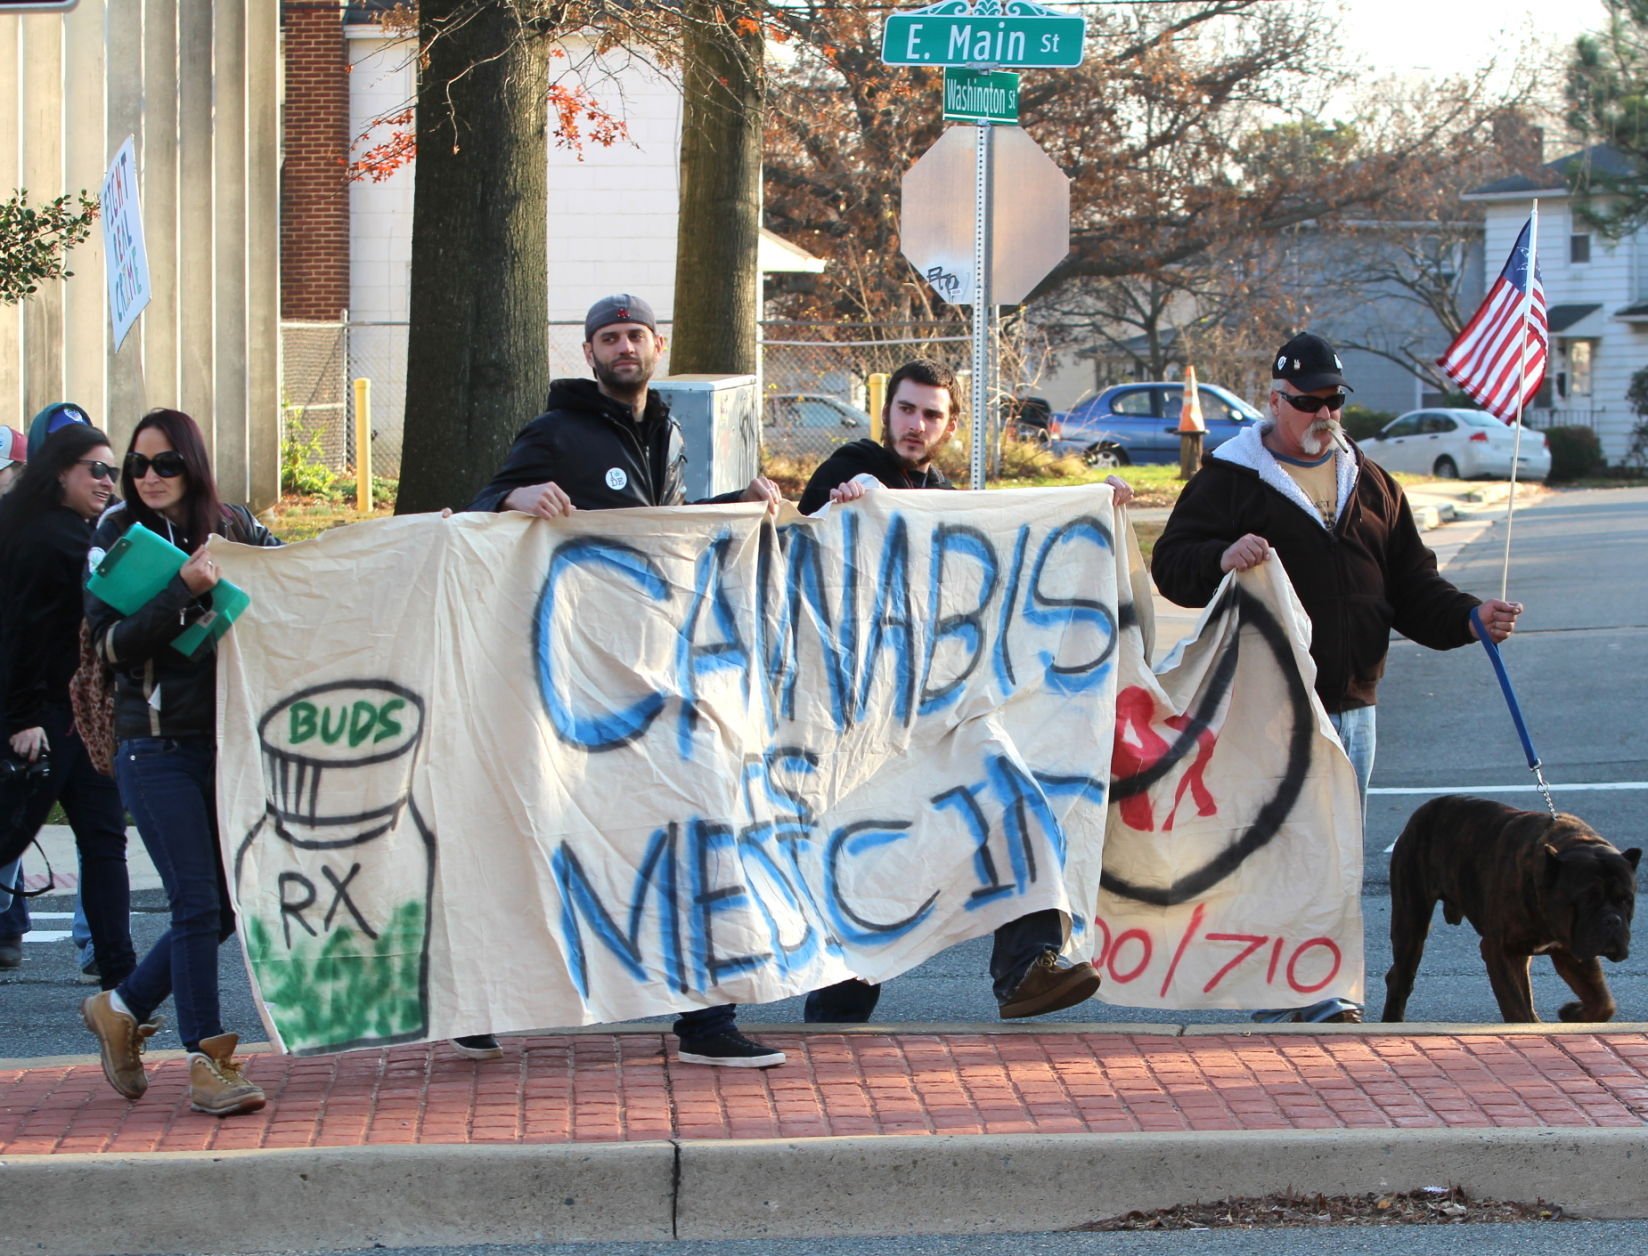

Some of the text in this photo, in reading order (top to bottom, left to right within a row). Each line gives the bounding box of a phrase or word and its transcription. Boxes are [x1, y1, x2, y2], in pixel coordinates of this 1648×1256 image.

[906, 21, 1061, 61] E. Main St
[946, 79, 1016, 118] Washington St
[104, 151, 129, 233] FIGHT
[289, 699, 406, 748] BUDS
[278, 862, 379, 950] RX
[552, 755, 1106, 1000] MEDICIN
